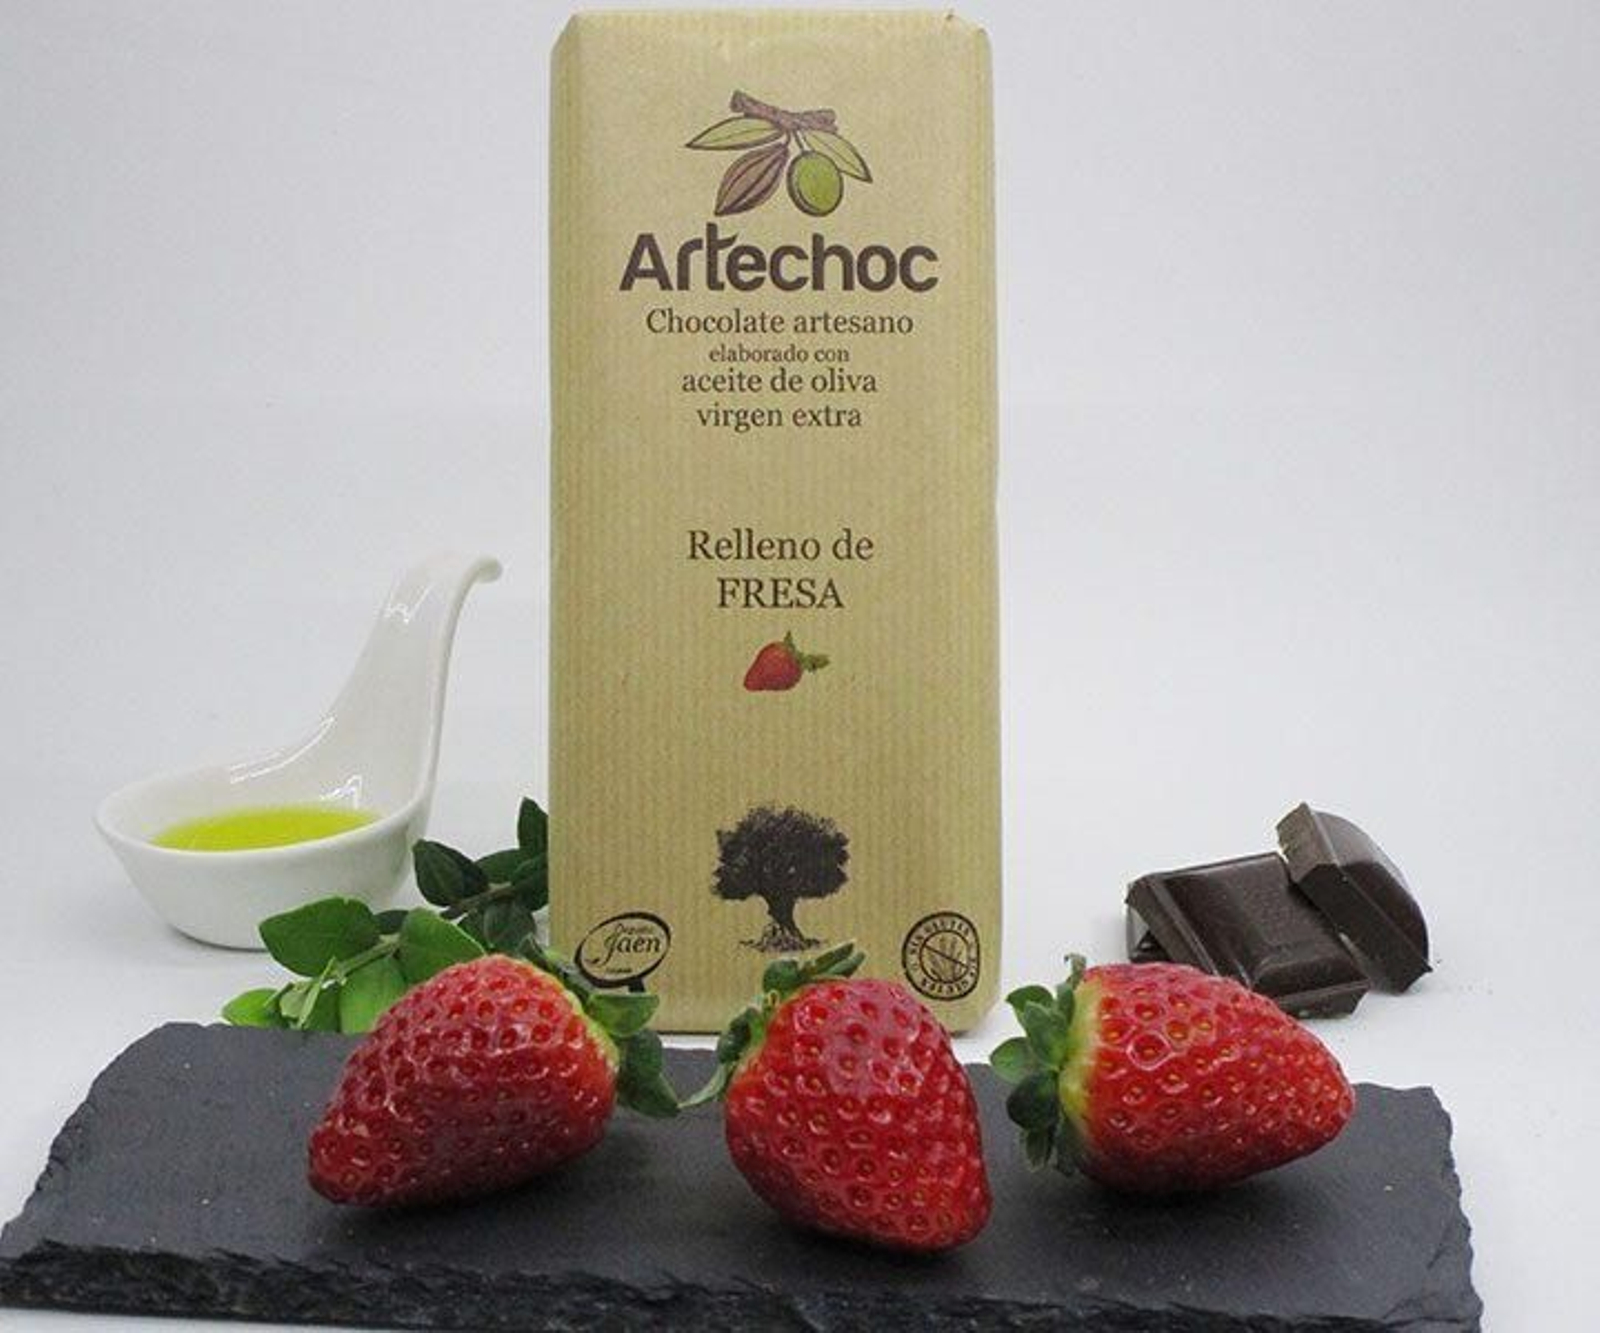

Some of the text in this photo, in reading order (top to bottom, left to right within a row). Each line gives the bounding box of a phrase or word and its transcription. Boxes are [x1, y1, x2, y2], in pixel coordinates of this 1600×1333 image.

[619, 222, 938, 292] Artechoc
[646, 308, 913, 334] Chocolate artesano
[709, 344, 849, 362] elaborado con
[682, 367, 877, 392] aceite de oliva
[696, 402, 862, 433] virgen extra
[687, 528, 874, 561] Relleno de
[717, 577, 844, 608] FRESA
